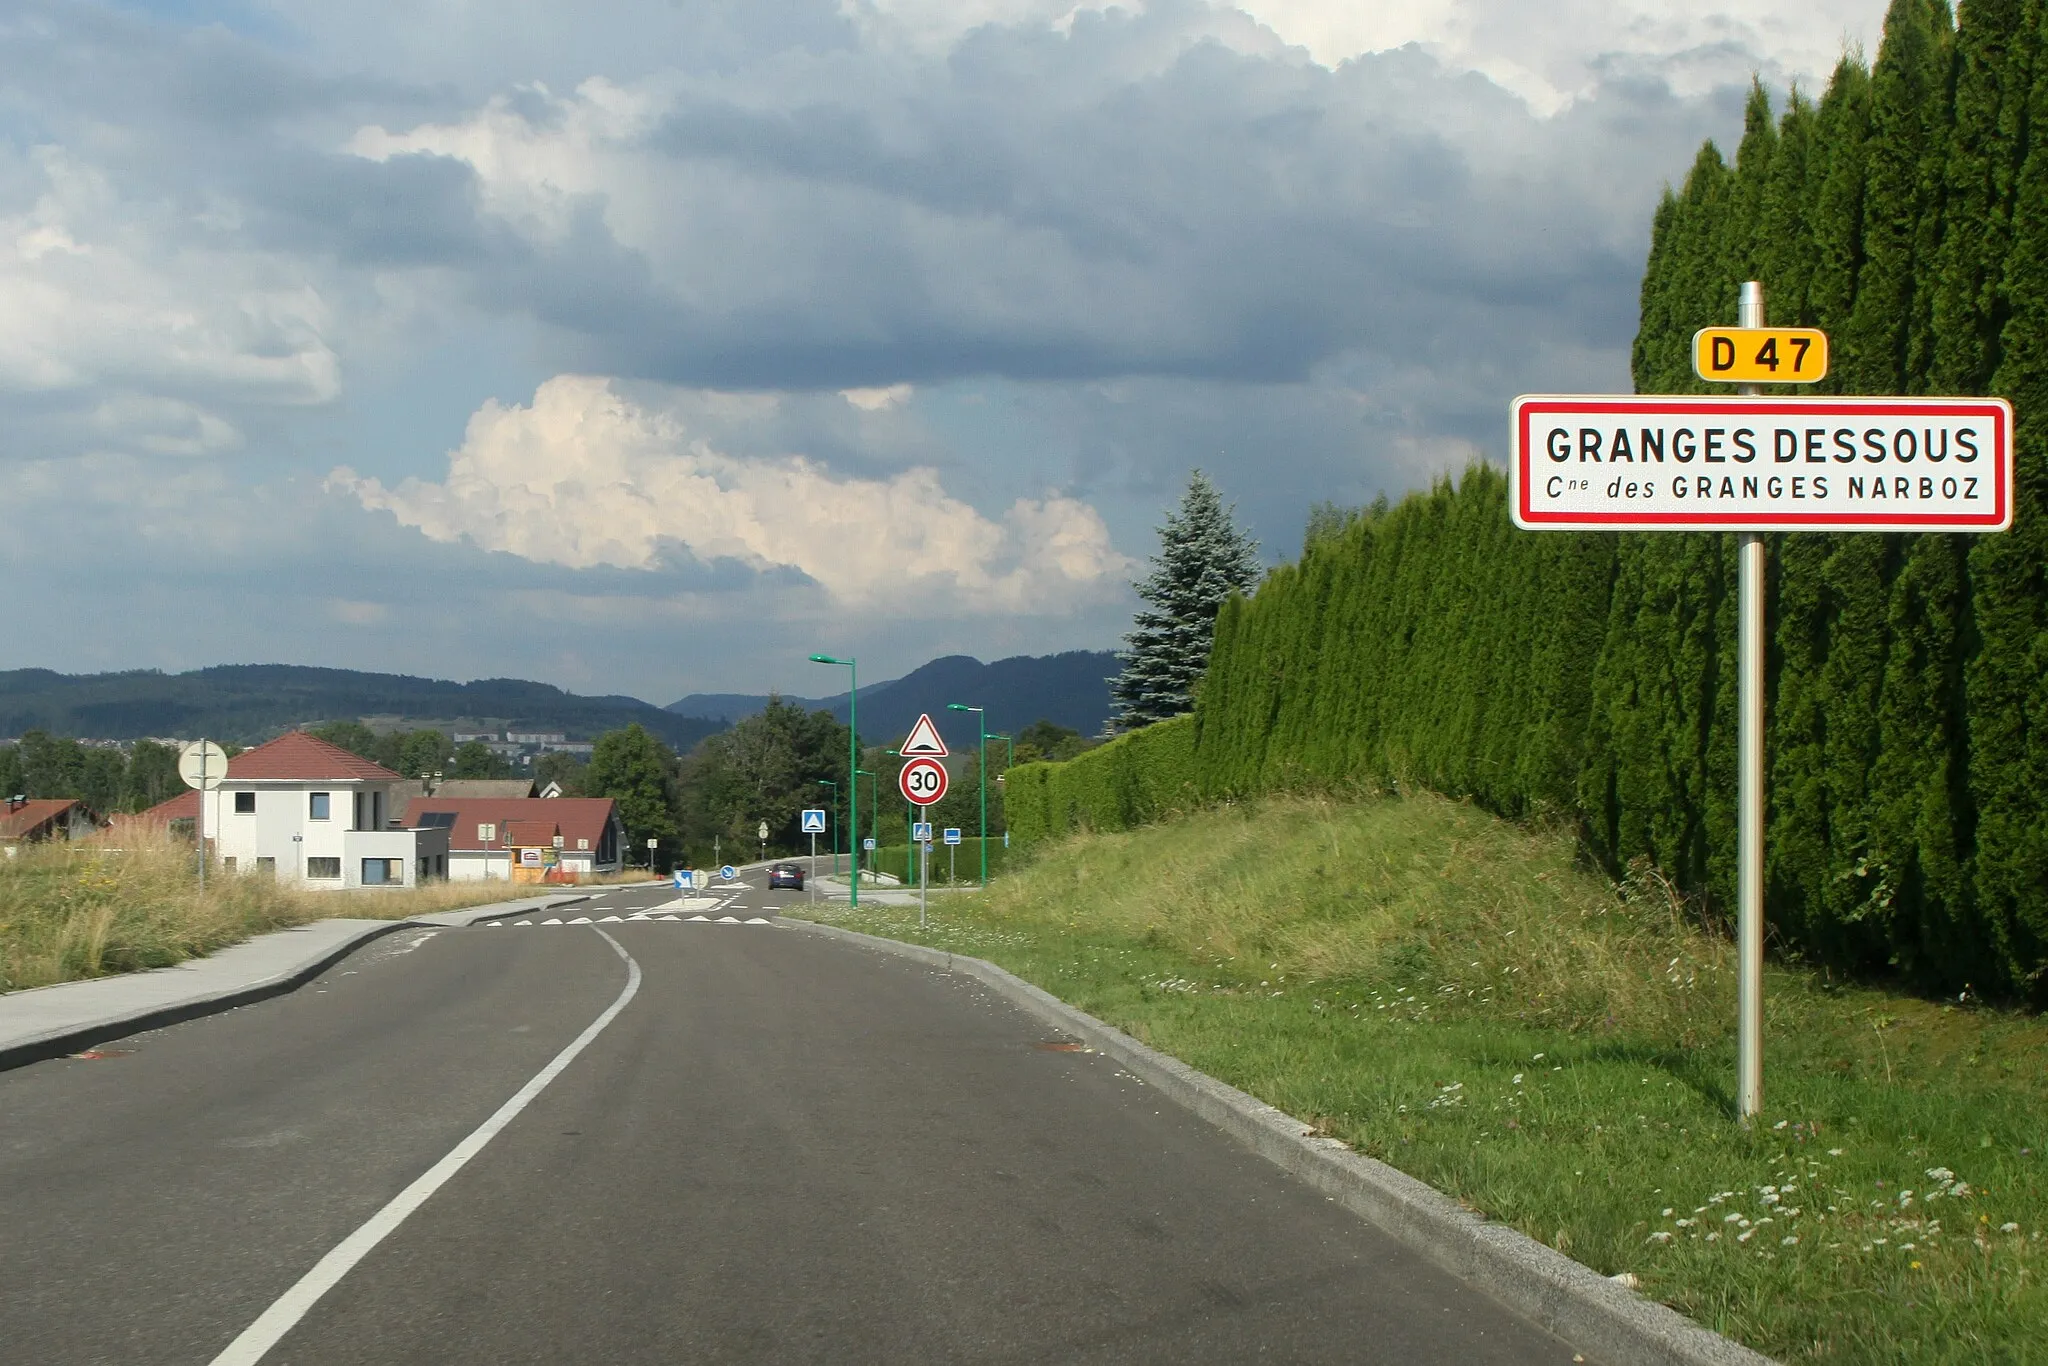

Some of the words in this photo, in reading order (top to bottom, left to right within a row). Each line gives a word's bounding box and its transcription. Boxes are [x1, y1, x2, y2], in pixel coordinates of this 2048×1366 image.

[1712, 337, 1735, 371] D
[1755, 338, 1811, 372] 47
[1547, 428, 1756, 464] GRANGES
[1774, 428, 1978, 464] DESSOUS
[1607, 476, 1654, 499] des
[1672, 476, 1828, 499] GRANGES
[1848, 476, 1978, 500] NARBOZ
[910, 771, 938, 791] 30
